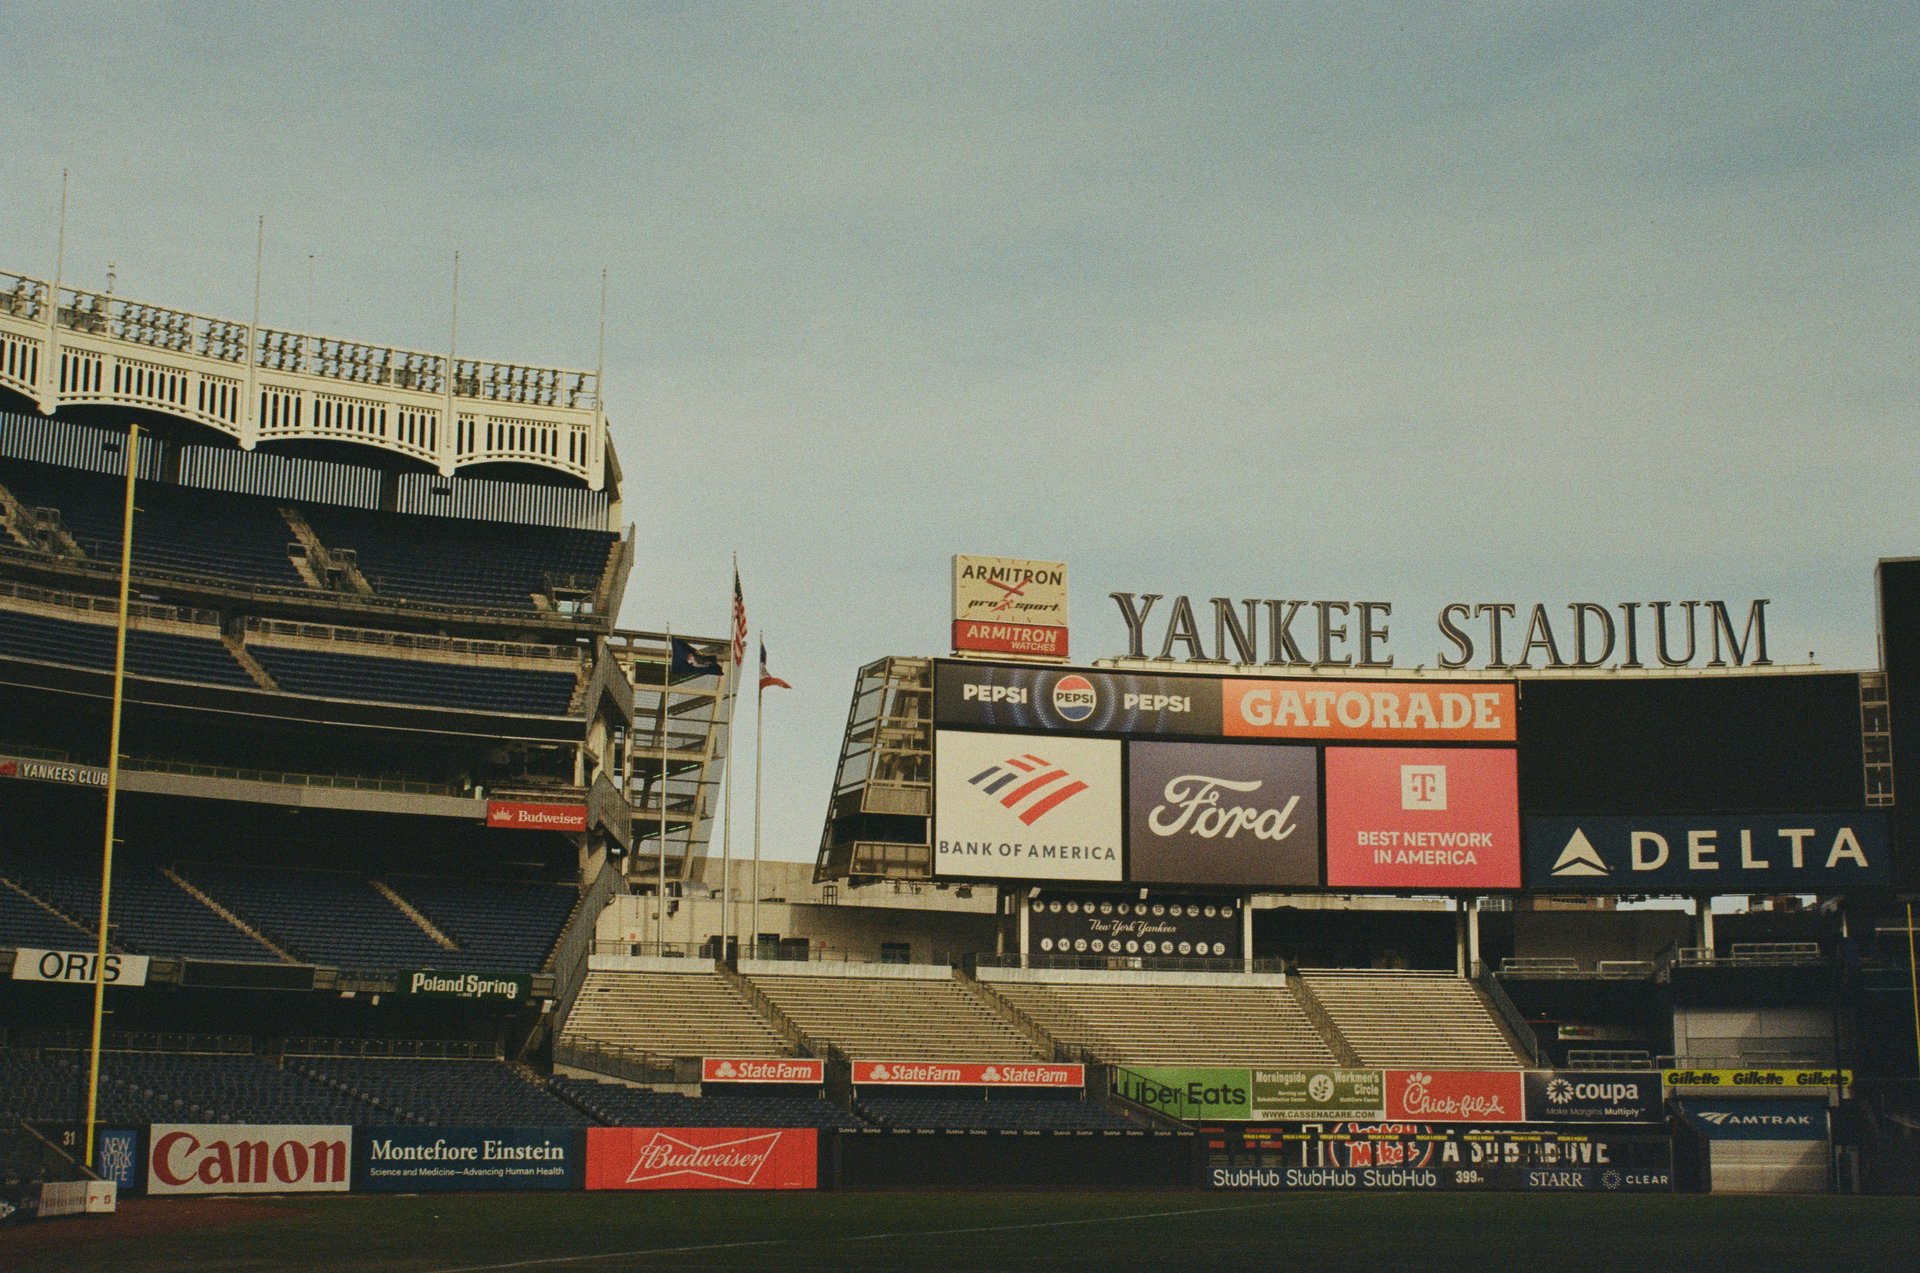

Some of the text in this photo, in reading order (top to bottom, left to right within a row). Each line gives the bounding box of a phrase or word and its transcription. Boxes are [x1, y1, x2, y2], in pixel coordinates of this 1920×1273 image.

[962, 565, 1062, 585] ARMITRON
[968, 600, 998, 608] pro
[967, 625, 1057, 643] ARMITRON
[1109, 592, 1772, 669] YANKEE STADIUM
[1012, 641, 1056, 652] WATCHES
[963, 684, 1027, 703] PEPSI
[1056, 692, 1094, 704] PEPSI
[1124, 693, 1191, 712] PEPSI
[1240, 690, 1501, 730] GATORADE
[23, 763, 109, 786] YANKEES CLUB
[518, 810, 584, 824] Budweiser
[1148, 775, 1299, 841] Ford
[1358, 831, 1493, 847] BEST NETWORK
[939, 840, 1116, 860] BANK OF AMERICA
[1374, 850, 1477, 865] IN AMERICA
[1631, 827, 1869, 871] DELTA
[1089, 919, 1176, 937] New York Yankees
[39, 952, 122, 982] ORIS
[411, 973, 517, 999] Poland Spring
[1256, 1071, 1307, 1085] Morningside
[1334, 1072, 1379, 1083] Workmen's
[1668, 1072, 1720, 1085] Gillette
[1733, 1073, 1784, 1086] Gillette
[1123, 1081, 1246, 1105] Uber Eats
[1354, 1084, 1379, 1095] Circle
[1576, 1082, 1639, 1104] coupa
[1570, 1108, 1602, 1117] Margins
[1604, 1108, 1639, 1117] Multiply
[1729, 1116, 1810, 1125] AMTRAK
[104, 1137, 131, 1152] NEW
[370, 1139, 564, 1160] Montefiore Einstein
[1442, 1130, 1460, 1162] A
[101, 1150, 132, 1167] YORK
[152, 1132, 346, 1186] Canon
[640, 1144, 765, 1169] Budweiser
[370, 1168, 401, 1176] Science
[402, 1168, 418, 1176] and
[505, 1167, 534, 1176] Human
[536, 1167, 564, 1176] Health
[1213, 1169, 1436, 1187] StubHub StubHub StubHub
[1455, 1171, 1478, 1183] 399
[1529, 1172, 1583, 1186] STARR
[1626, 1175, 1668, 1184] CLEAR
